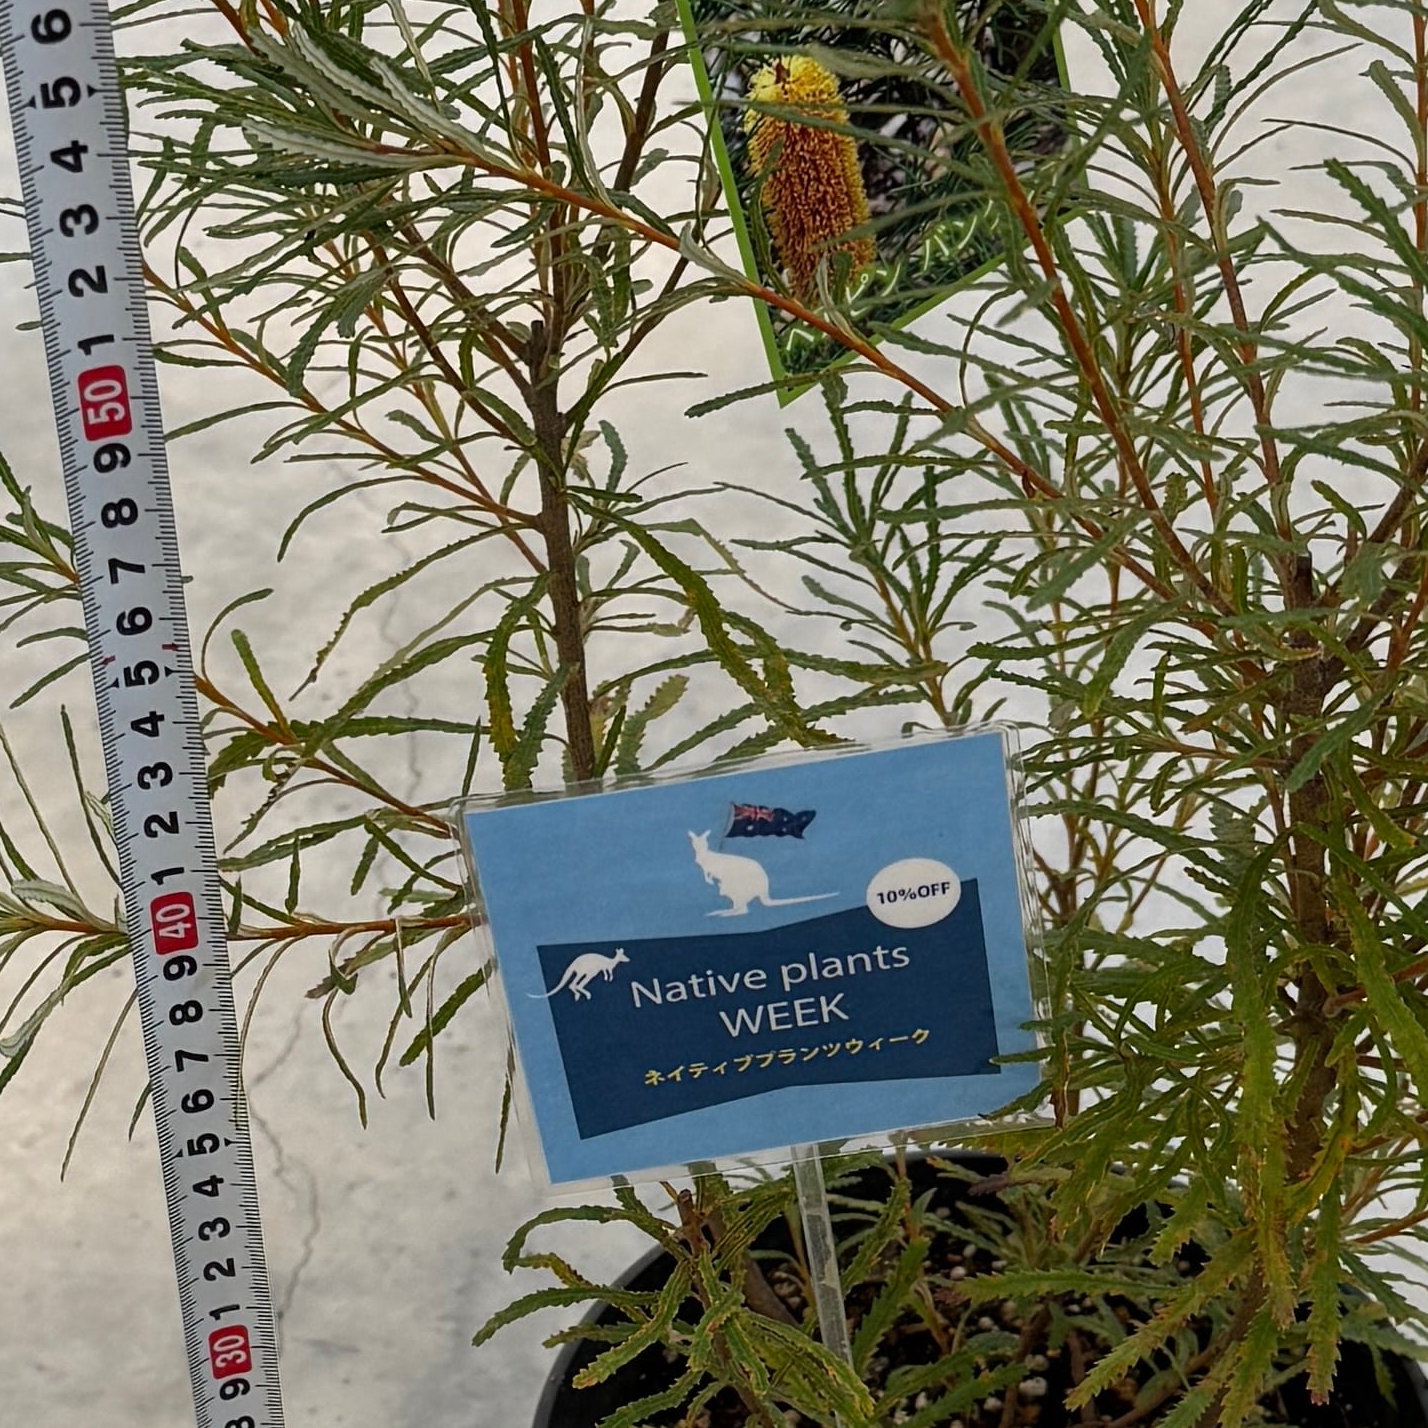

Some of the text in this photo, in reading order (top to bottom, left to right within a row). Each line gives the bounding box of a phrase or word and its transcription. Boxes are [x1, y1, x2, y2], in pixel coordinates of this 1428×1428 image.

[31, 9, 71, 44] 6
[40, 77, 81, 108] 5
[50, 140, 88, 173] 4
[59, 204, 99, 237] 3
[68, 266, 108, 297] 2
[78, 334, 114, 355] 1
[84, 380, 125, 424] 50
[94, 443, 131, 473] 9
[101, 498, 138, 528] 8
[108, 558, 145, 584] 7
[116, 607, 152, 635] 6
[124, 661, 159, 687] 5
[131, 711, 164, 737] 4
[138, 762, 173, 789] 3
[144, 811, 179, 838] 2
[151, 867, 184, 885] 1
[876, 881, 951, 905] 10%OFF
[156, 904, 191, 938] 40
[163, 955, 197, 981] 9
[630, 945, 911, 1009] Native plants
[169, 1000, 203, 1025] 8
[719, 992, 850, 1038] WEEK
[175, 1050, 209, 1072] 7
[644, 1028, 931, 1087] ネイティブプランツウィーク
[181, 1089, 214, 1113] 6
[187, 1133, 219, 1156] 5
[193, 1175, 224, 1197] 4
[198, 1217, 230, 1241] 3
[203, 1258, 235, 1281] 2
[209, 1304, 240, 1320] 1
[213, 1335, 246, 1367] 30
[220, 1378, 250, 1400] 9
